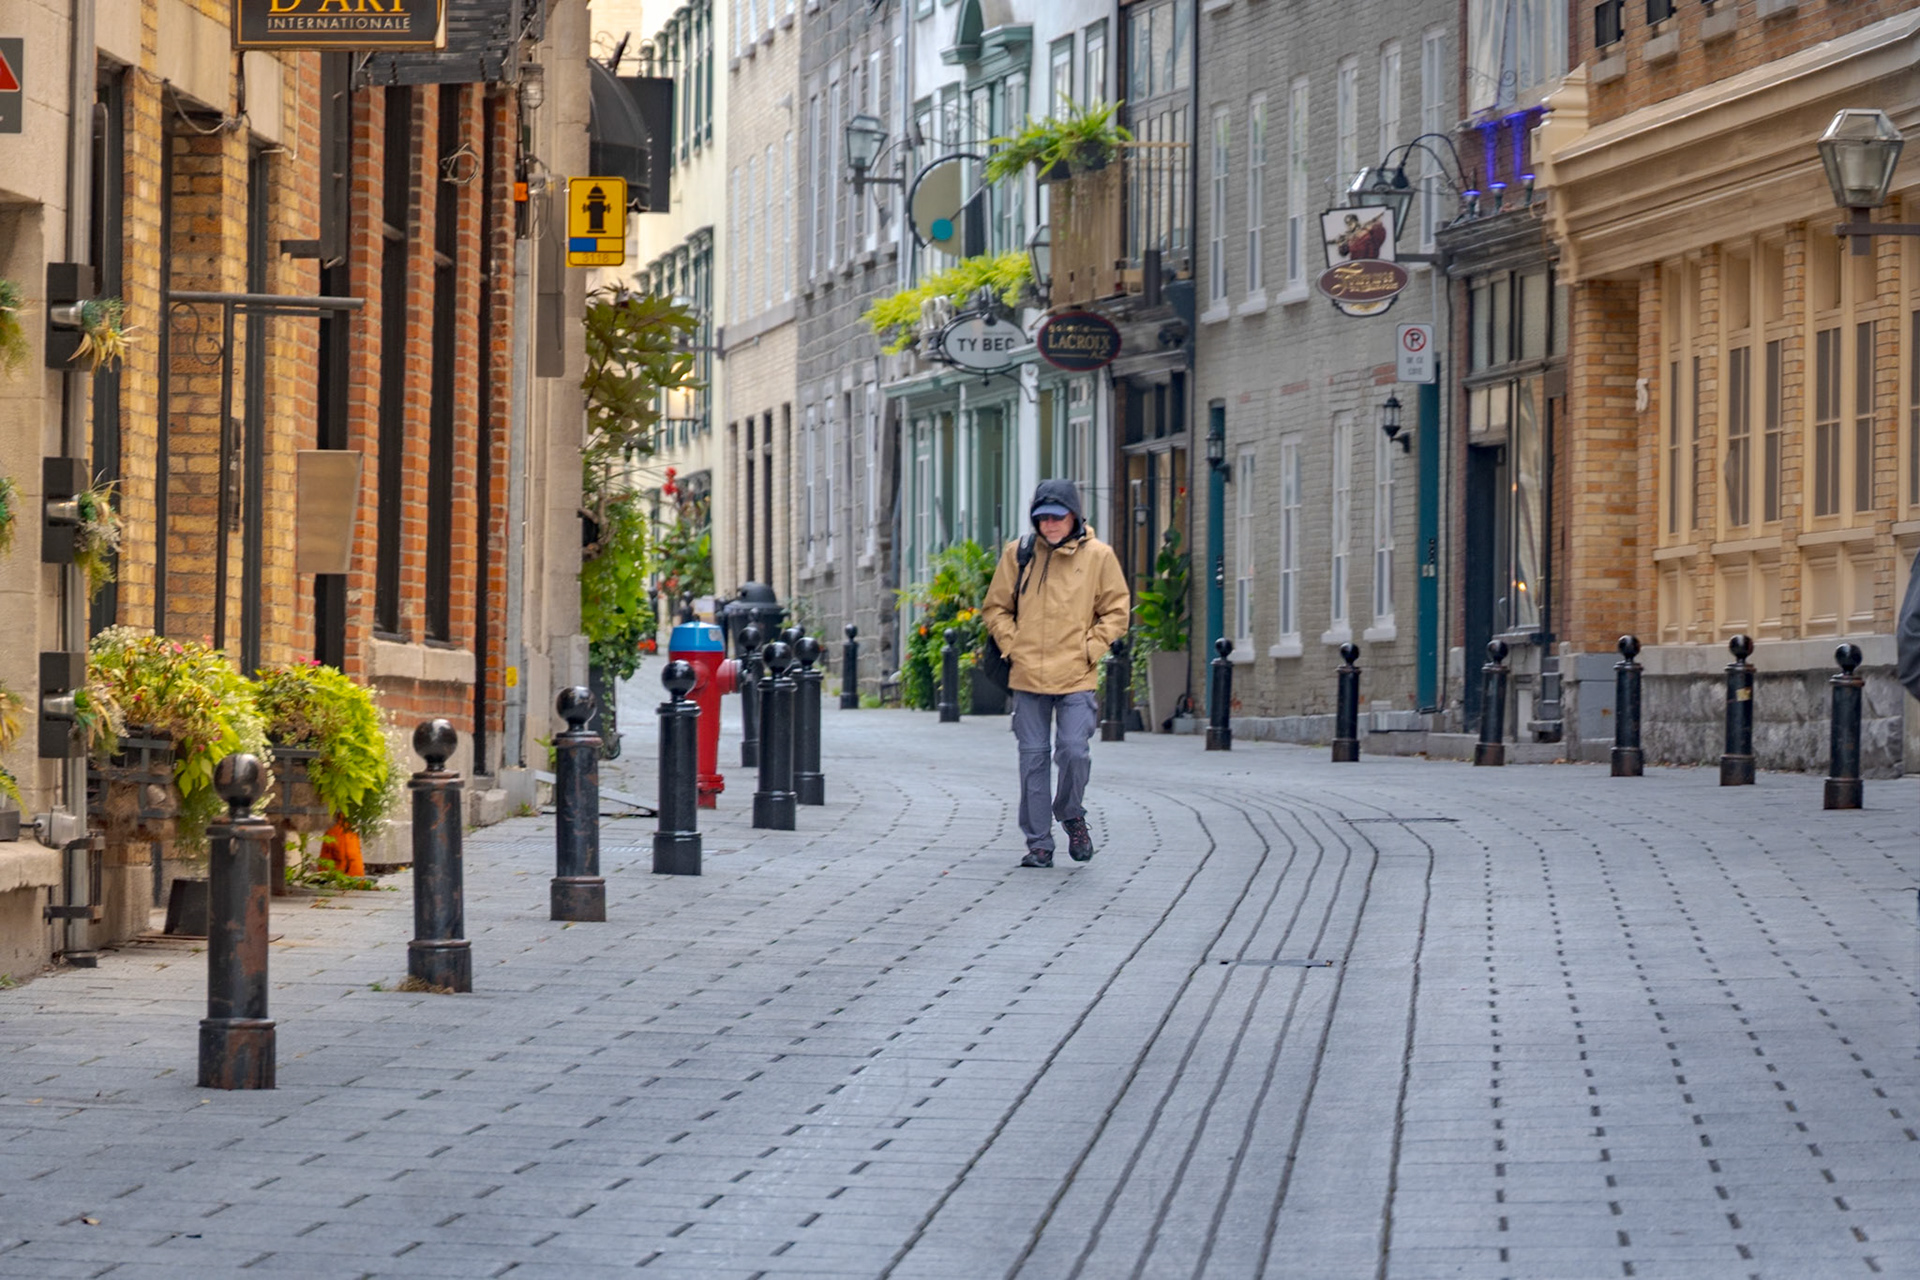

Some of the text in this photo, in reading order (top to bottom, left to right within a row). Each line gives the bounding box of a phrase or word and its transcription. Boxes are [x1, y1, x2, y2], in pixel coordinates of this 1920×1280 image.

[267, 17, 411, 29] INTERNATIONALE
[582, 253, 610, 263] 3118
[957, 337, 1015, 352] TY BEC
[1048, 333, 1111, 350] LACROIX
